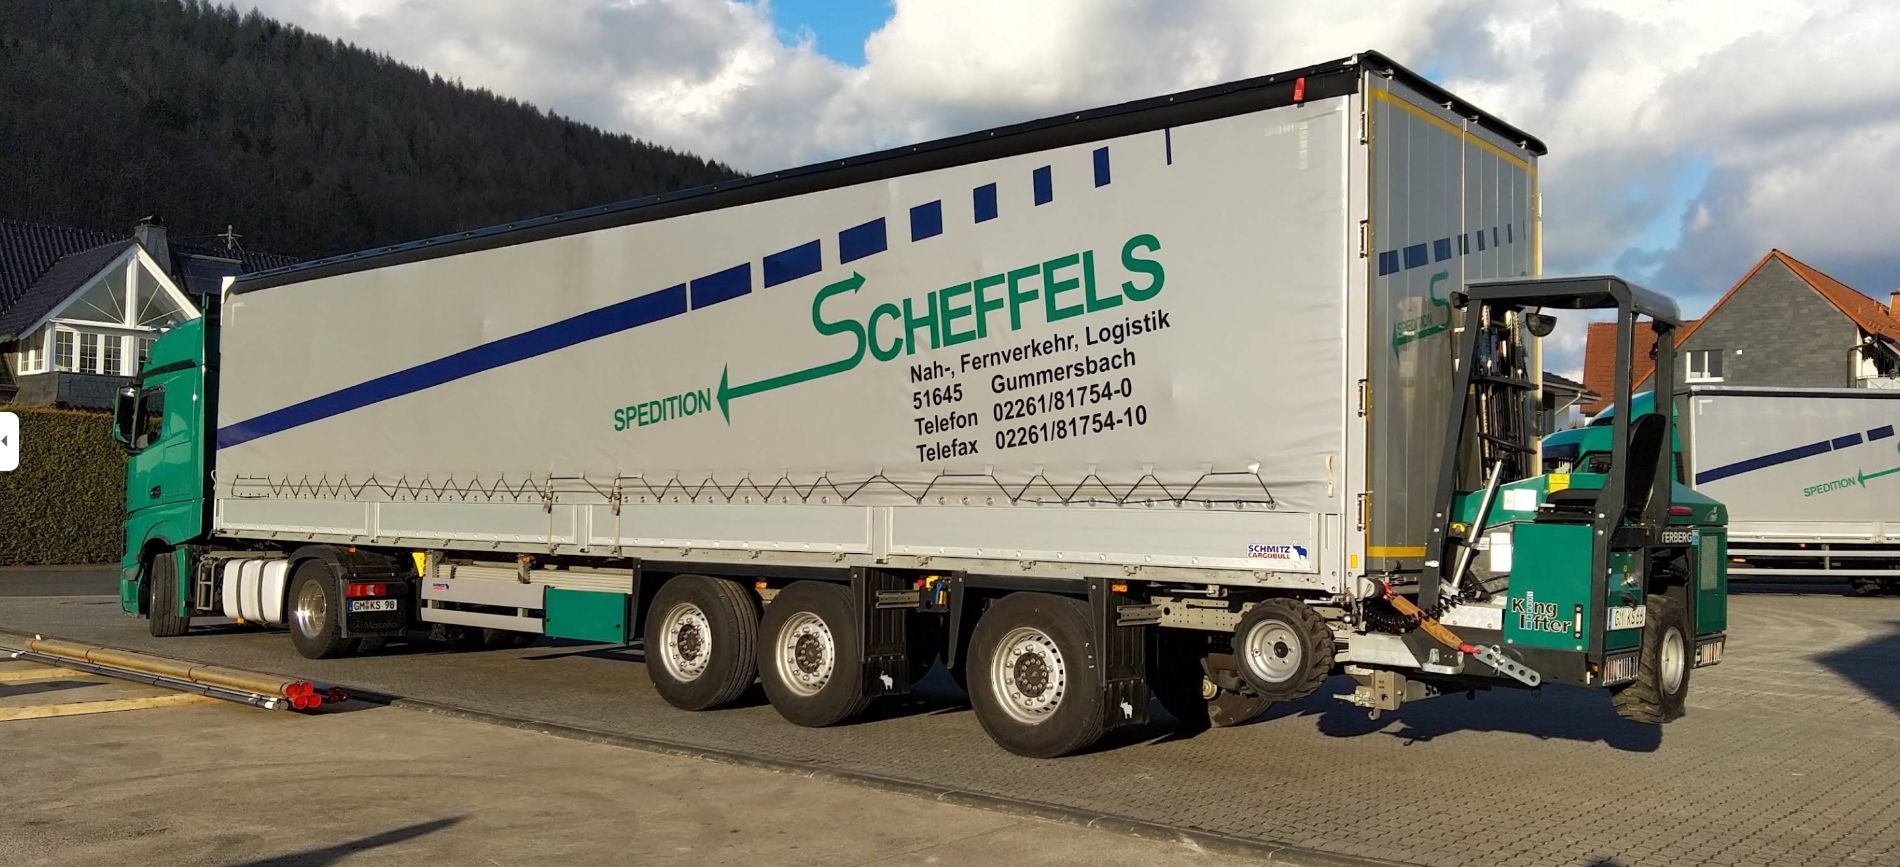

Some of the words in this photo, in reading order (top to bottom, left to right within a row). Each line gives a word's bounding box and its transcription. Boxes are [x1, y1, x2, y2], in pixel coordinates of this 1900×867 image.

[812, 233, 1166, 371] SCHEFFELS
[910, 360, 956, 385] Nah-,
[960, 334, 1080, 374] Fernverkehr,
[1085, 309, 1172, 345] Logistik
[913, 383, 964, 410] 51645
[991, 347, 1137, 394] Gummersbach
[914, 411, 979, 436] Telefon
[993, 377, 1133, 422] 02261/81754-0
[613, 387, 712, 432] SPEDITION
[916, 438, 980, 463] Telefax
[995, 404, 1148, 450] 02261/81754-10
[1803, 477, 1856, 497] SPEDITION
[1248, 545, 1291, 553] SCHMITZ
[353, 601, 366, 611] GM
[370, 600, 382, 610] KS
[384, 600, 395, 610] 98
